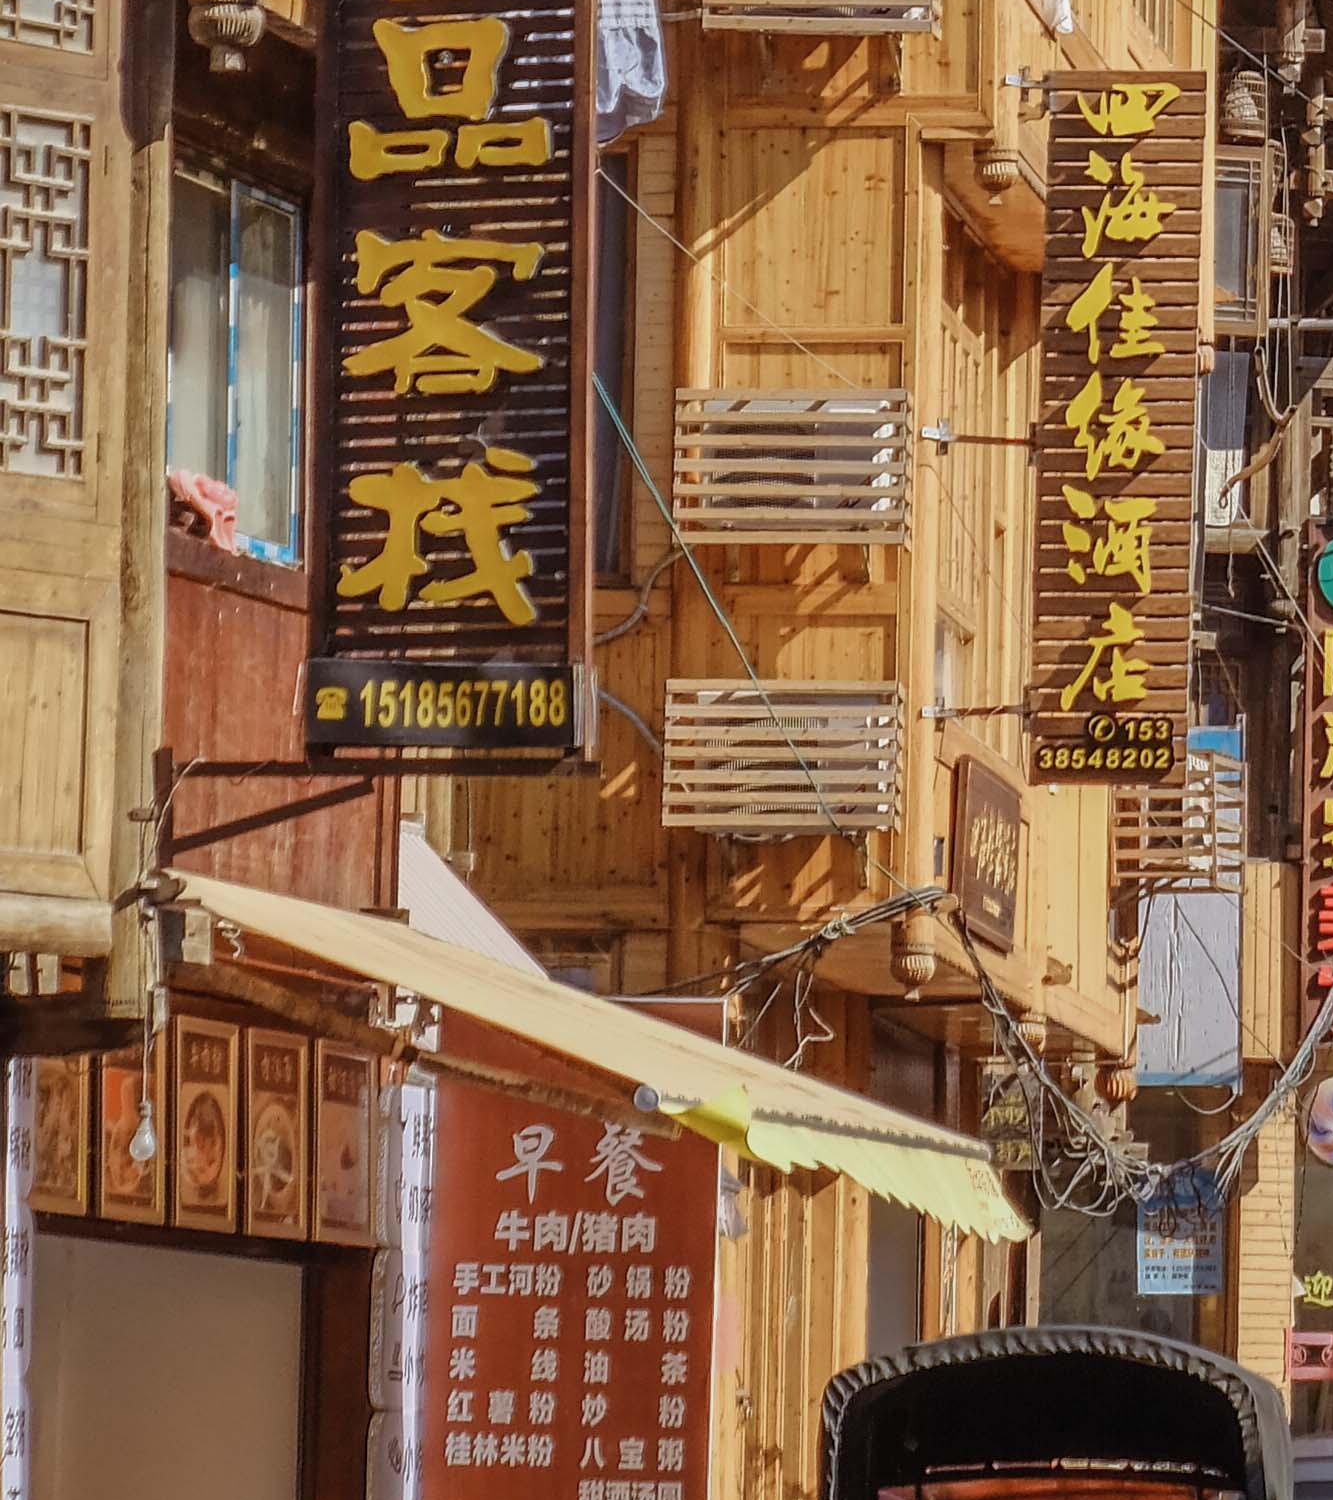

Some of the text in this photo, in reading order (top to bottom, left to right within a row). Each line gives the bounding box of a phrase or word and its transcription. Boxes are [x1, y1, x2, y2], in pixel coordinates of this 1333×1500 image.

[1060, 82, 1179, 712] 四海佳缘酒店
[359, 679, 567, 729] 15185677188
[1125, 720, 1170, 742] 153
[1038, 747, 1170, 770] 38548202
[496, 1122, 663, 1206] 早餐
[494, 1210, 657, 1256] 牛肉/猪肉
[453, 1263, 562, 1298] 手工河粉
[586, 1264, 692, 1300] 砂锅粉
[451, 1304, 561, 1341] 面条
[584, 1307, 690, 1343] 酸汤粉
[448, 1348, 560, 1383] 米线
[583, 1350, 687, 1388] 油茶
[446, 1389, 557, 1426] 红薯粉
[581, 1394, 686, 1430] 炒粉
[444, 1432, 555, 1467] 桂林米粉
[579, 1436, 684, 1473] 八宝粥
